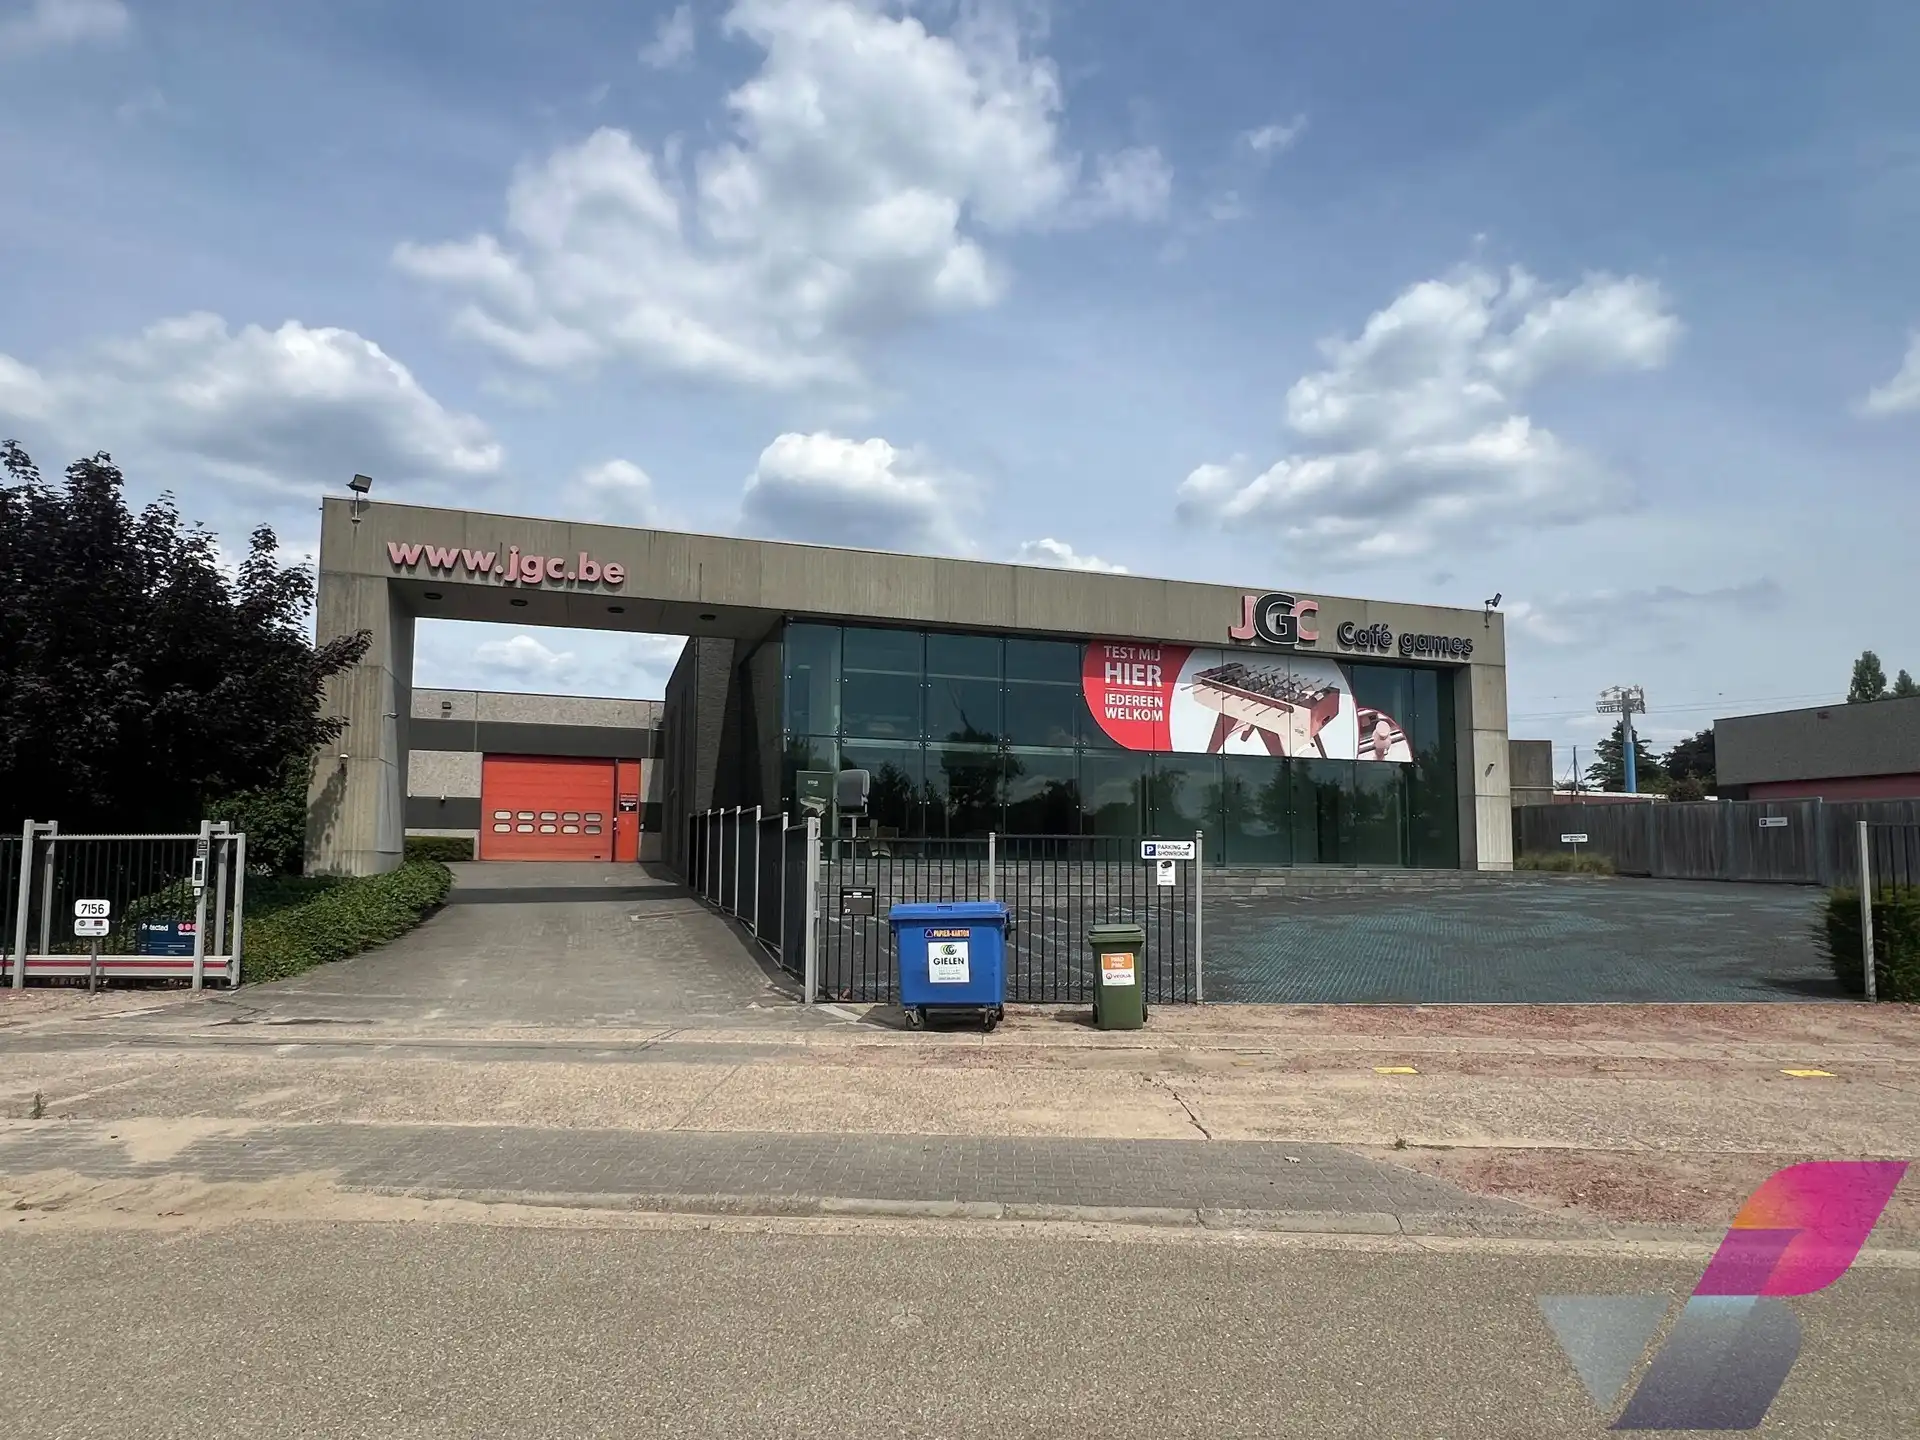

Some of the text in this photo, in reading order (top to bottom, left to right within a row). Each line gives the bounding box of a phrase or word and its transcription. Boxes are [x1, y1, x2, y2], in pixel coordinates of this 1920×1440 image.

[387, 541, 625, 584] www.jgc.be
[1229, 592, 1319, 645] JGC
[1338, 621, 1473, 656] Café games
[1104, 645, 1161, 661] TEST MIJ
[1104, 661, 1163, 688] HIER
[1105, 693, 1163, 707] IEDEREEN
[1105, 707, 1163, 721] WELKOM
[80, 903, 105, 914] 7156
[141, 923, 169, 931] Prtected
[933, 957, 965, 966] GIELEN
